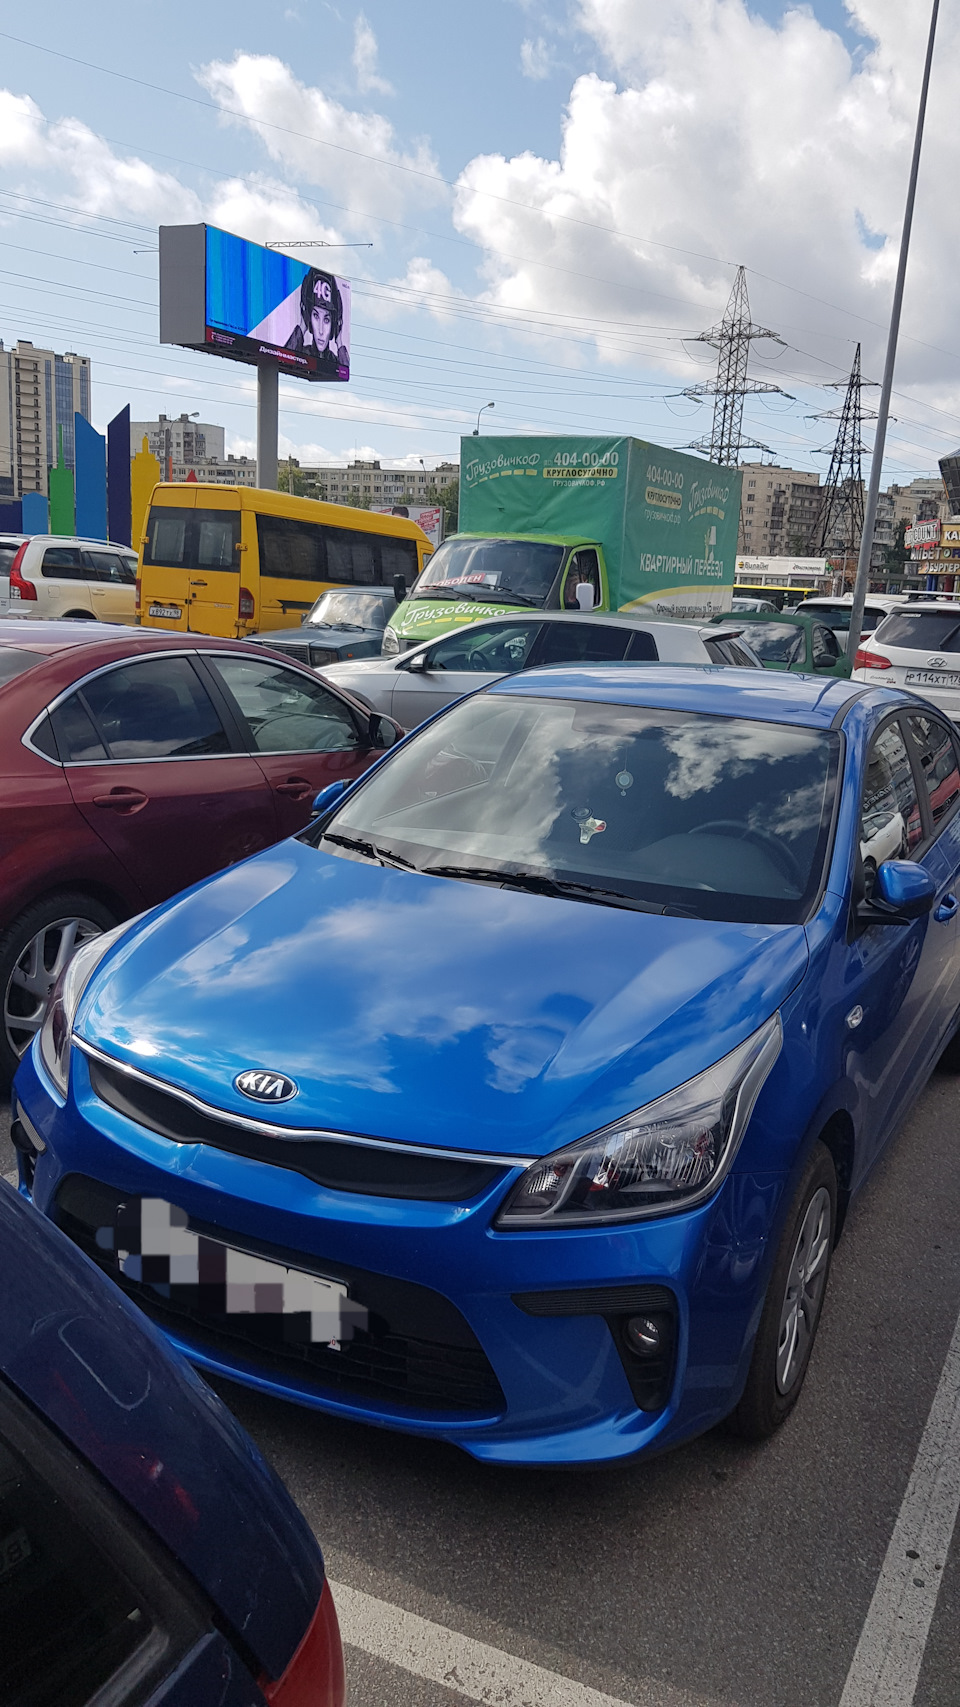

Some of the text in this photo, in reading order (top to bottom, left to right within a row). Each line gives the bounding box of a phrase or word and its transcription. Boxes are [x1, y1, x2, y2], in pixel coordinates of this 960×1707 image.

[313, 280, 332, 302] 4G
[554, 452, 619, 466] 404-00-00
[547, 469, 614, 477] КРУГЛОСУТОЧНО
[646, 464, 684, 489] 404-00-00
[945, 531, 960, 540] КА
[640, 553, 723, 579] КВАРТИРНЫЙ ПЕРЕЕЗД
[929, 562, 960, 573] БУРГЕР
[427, 575, 482, 590] ОБОДЕН
[401, 602, 521, 627] Грузовичко
[241, 1072, 285, 1098] KIA
